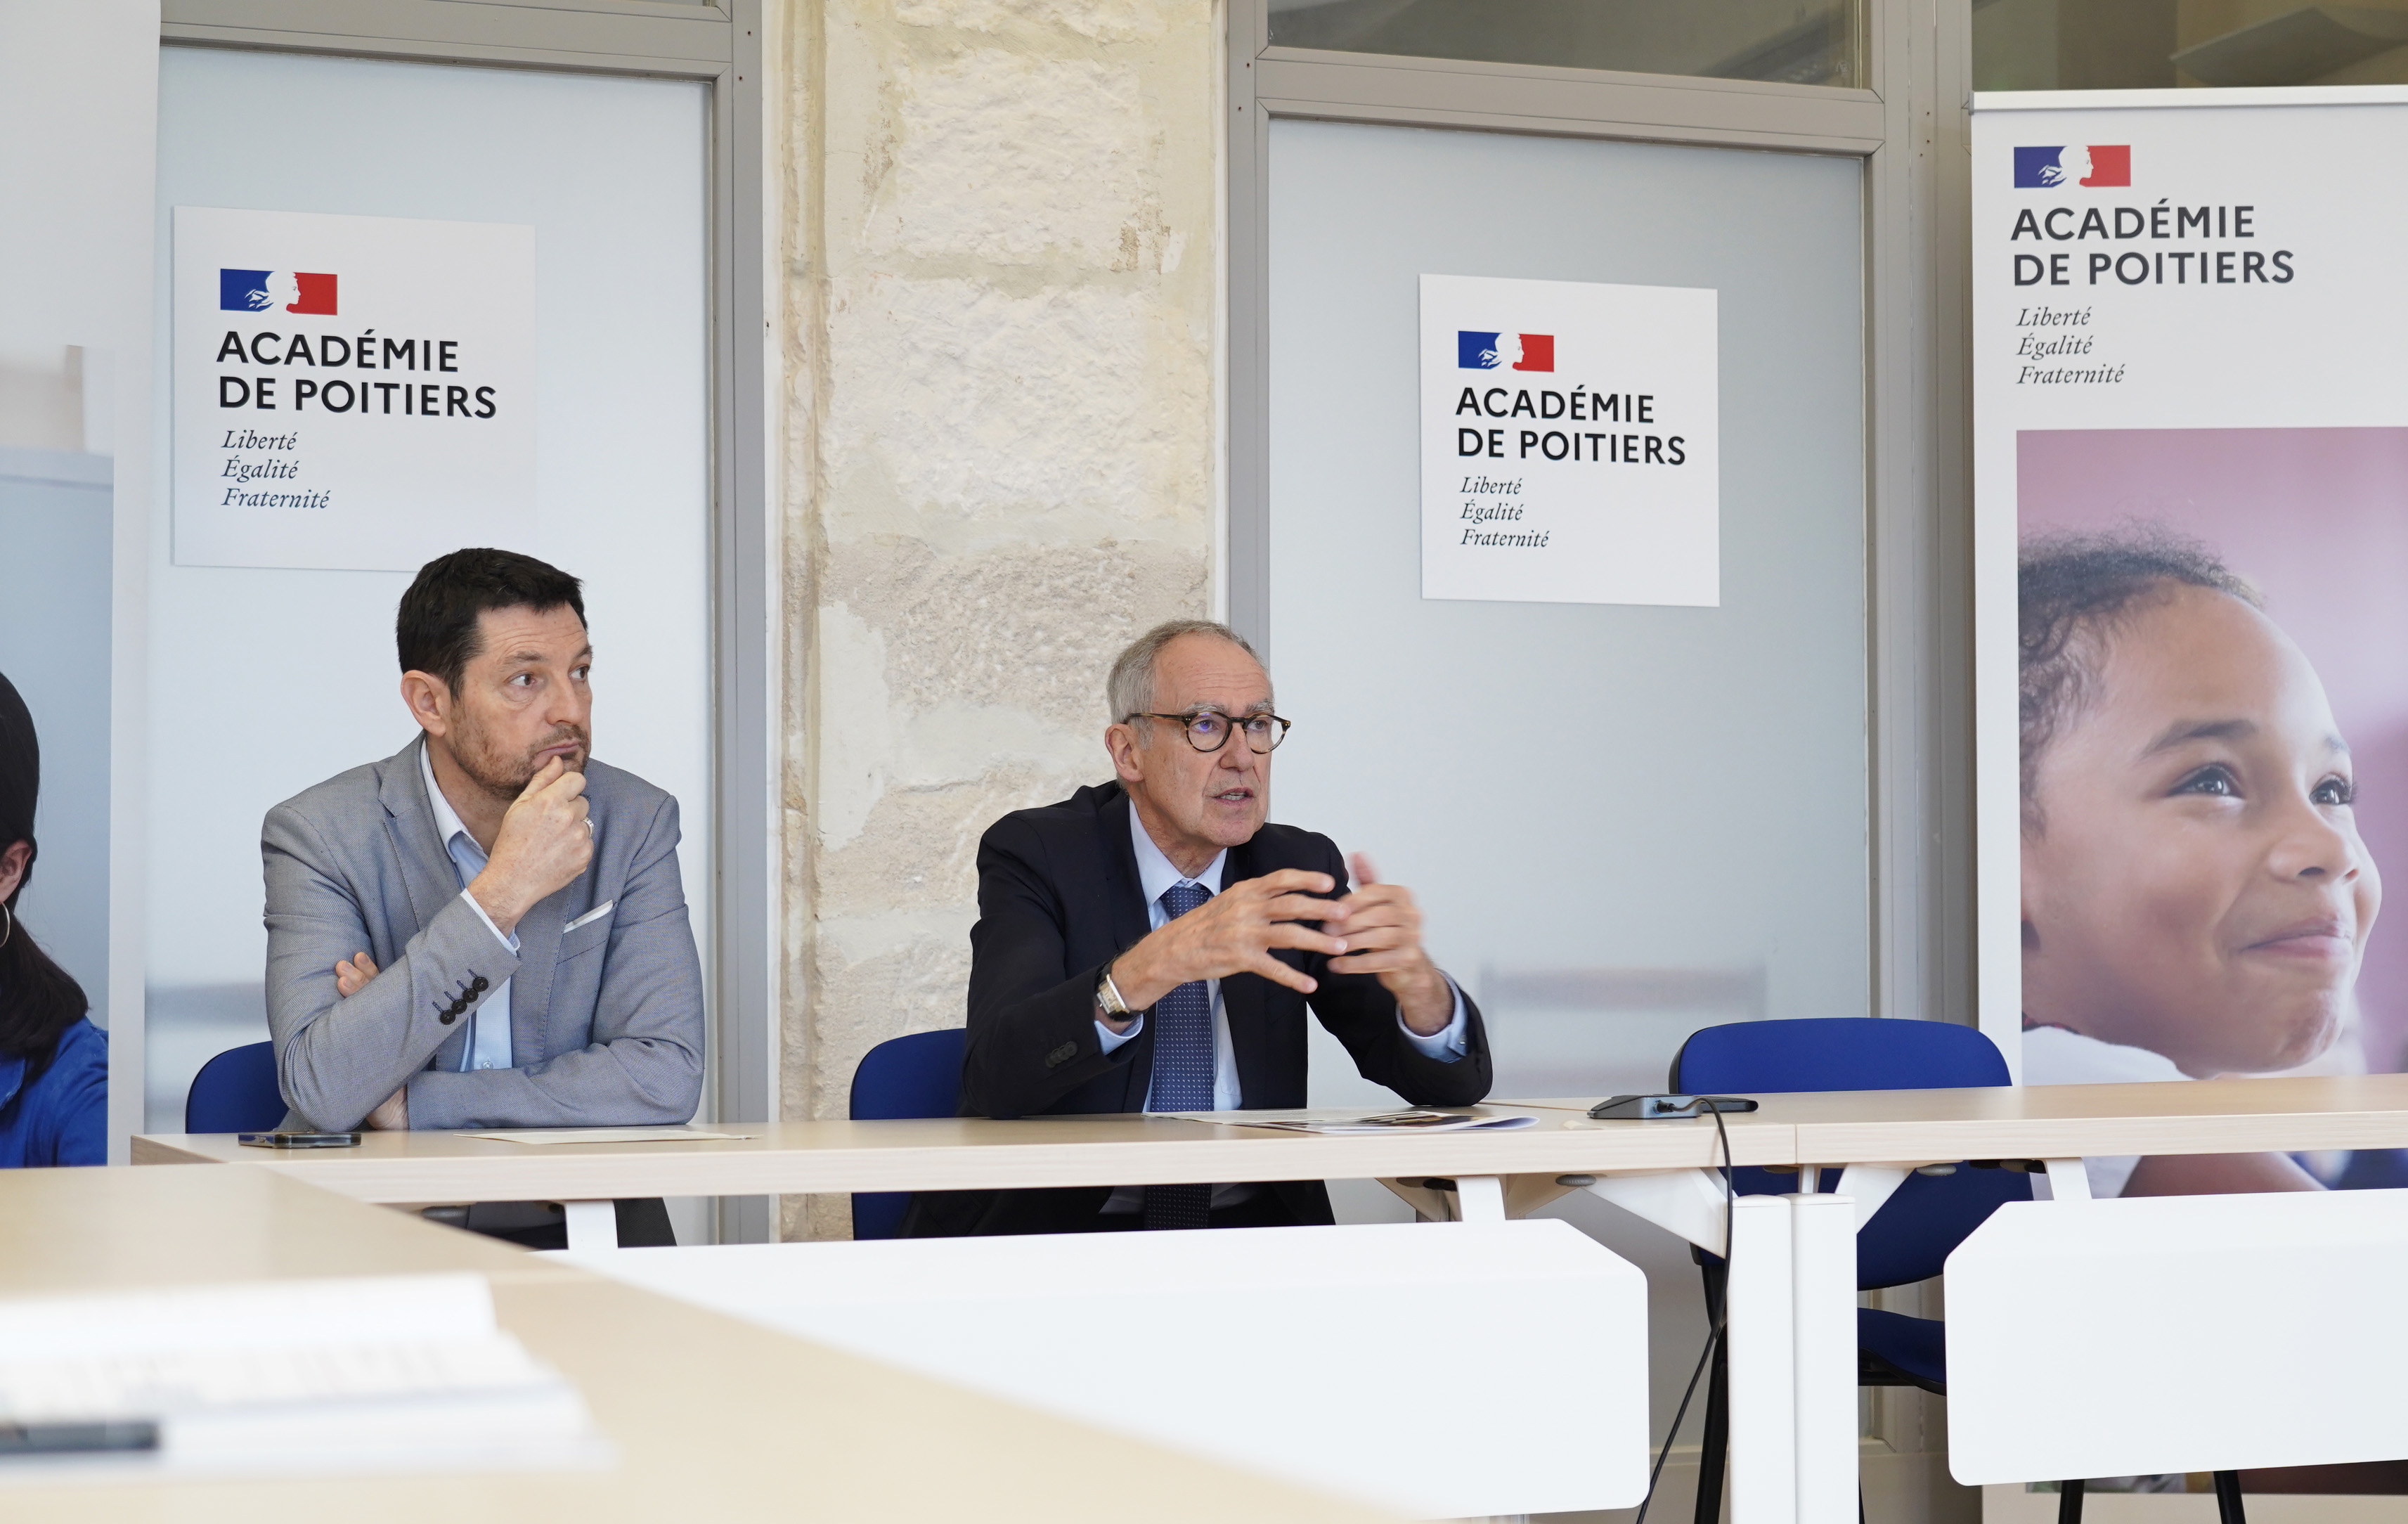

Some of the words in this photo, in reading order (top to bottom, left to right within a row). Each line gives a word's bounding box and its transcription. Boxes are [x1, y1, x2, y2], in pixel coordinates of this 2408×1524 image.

[2010, 198, 2255, 241] ACADÉMIE
[2014, 253, 2070, 286] DE
[2089, 250, 2294, 285] POITIERS
[2016, 306, 2092, 326] Liberté
[216, 328, 458, 373] ACADÉMIE
[2016, 332, 2092, 361] Égalité
[2017, 363, 2125, 384] Fraternité
[219, 375, 276, 410] DE
[295, 379, 497, 419] POITIERS
[1455, 384, 1654, 424] ACADÉMIE
[221, 429, 298, 451] Liberté
[1458, 427, 1505, 458] DE
[1520, 430, 1686, 466] POITIERS
[221, 455, 299, 483] Égalité
[221, 488, 331, 509] Fraternité
[1459, 476, 1522, 495] Liberté
[1459, 499, 1524, 524] Égalité
[1460, 529, 1550, 548] Fraternité
